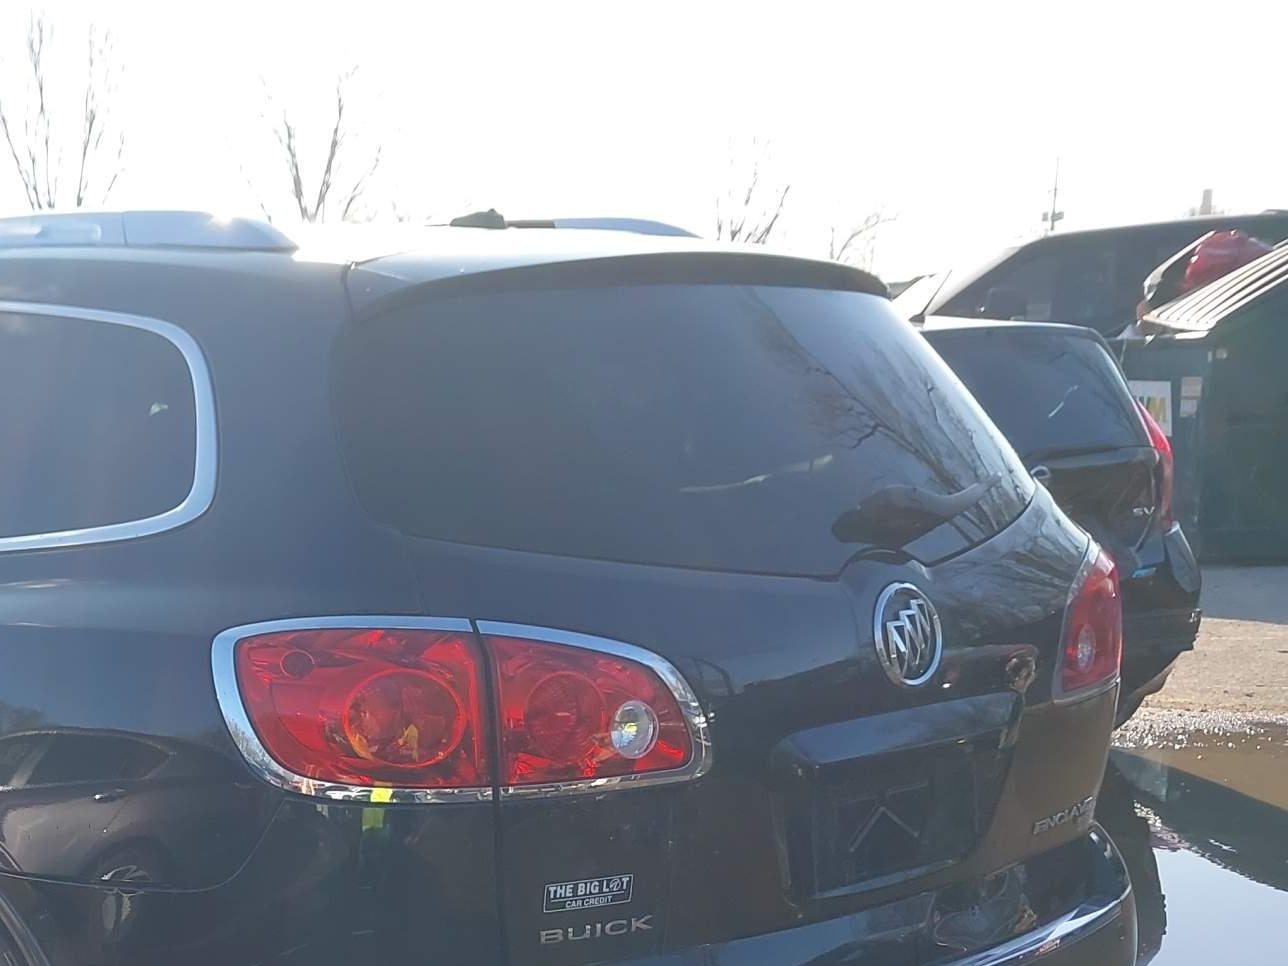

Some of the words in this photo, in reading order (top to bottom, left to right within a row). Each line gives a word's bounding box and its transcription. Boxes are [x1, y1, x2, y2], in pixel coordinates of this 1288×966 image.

[548, 885, 574, 899] THE
[577, 881, 599, 895] BIG
[565, 900, 583, 909] CAR
[583, 896, 613, 907] CREDIT
[539, 914, 654, 945] BUICK
